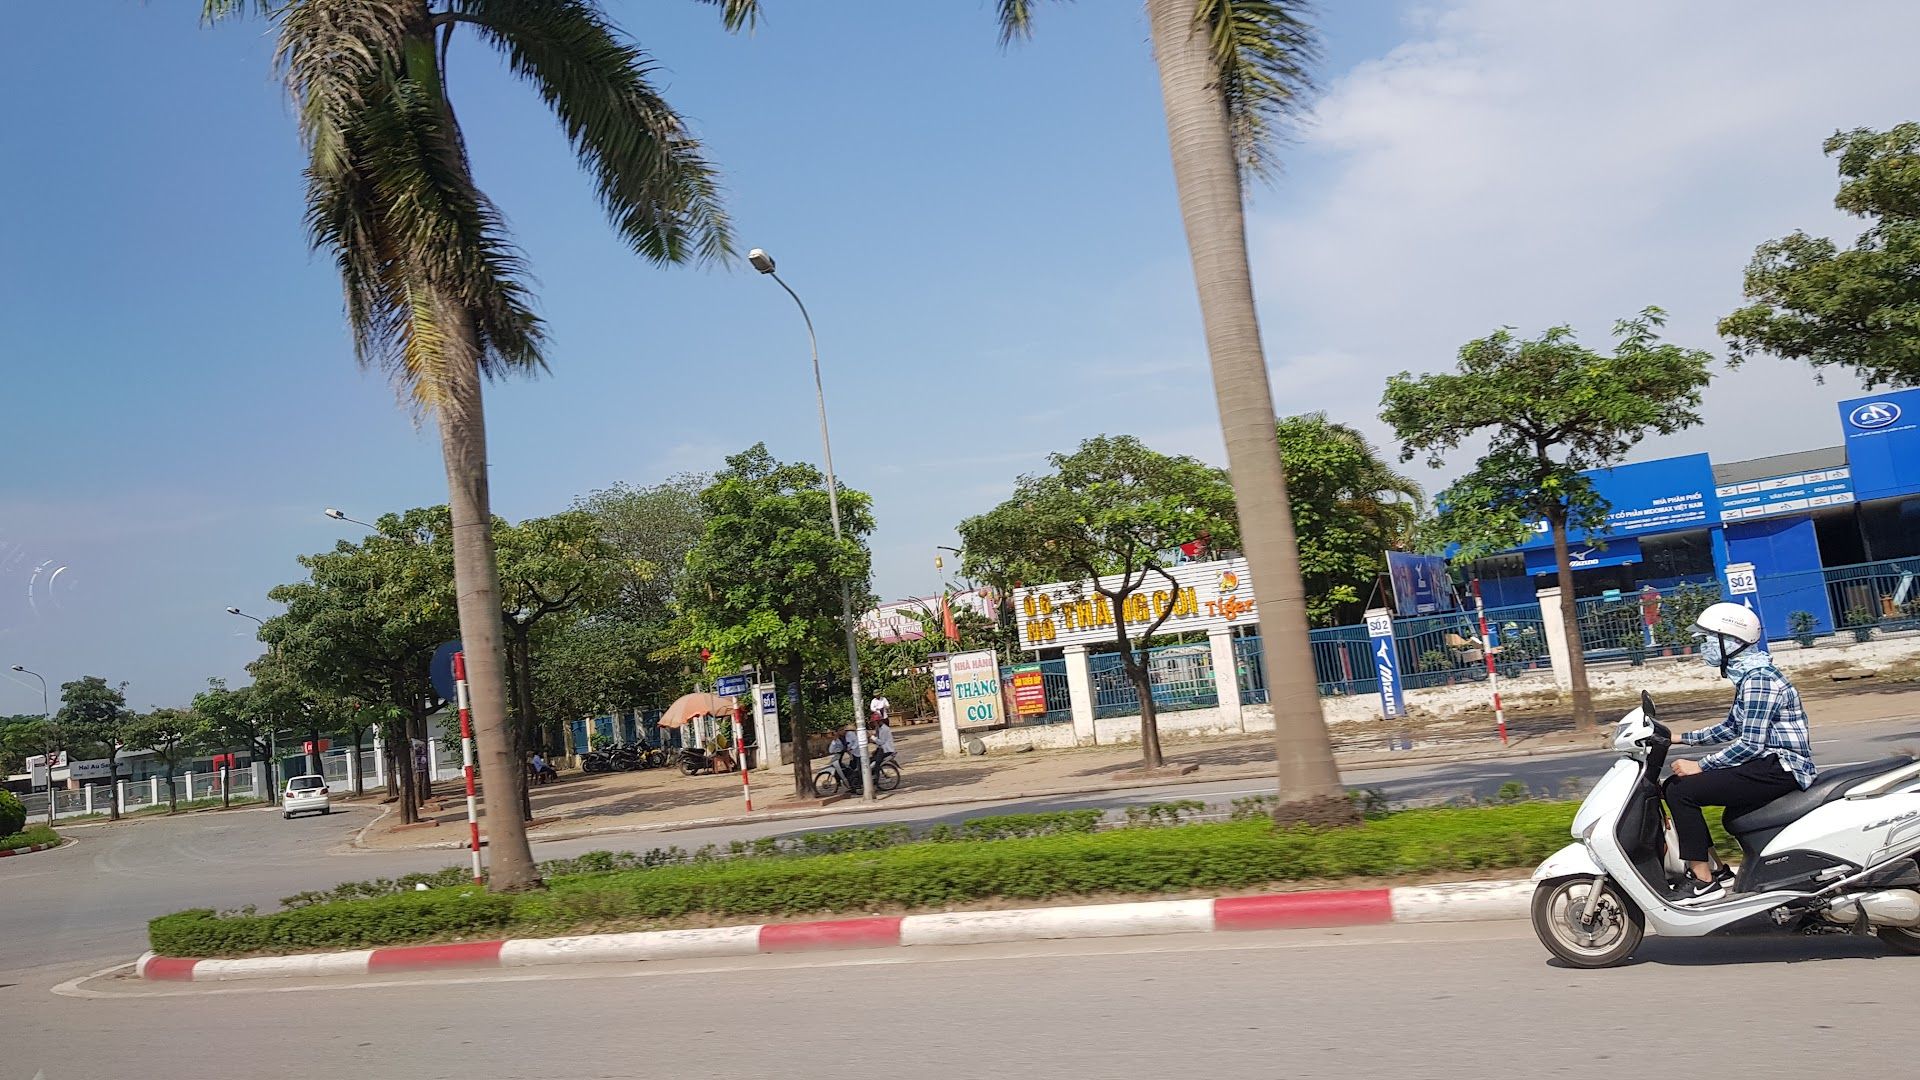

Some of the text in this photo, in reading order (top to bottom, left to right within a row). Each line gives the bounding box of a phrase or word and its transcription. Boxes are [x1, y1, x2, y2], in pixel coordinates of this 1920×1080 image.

[1745, 576, 1753, 586] 2
[1205, 595, 1254, 620] Tiger
[1382, 620, 1389, 630] 2
[945, 680, 950, 690] 6
[967, 700, 994, 721] CÒI
